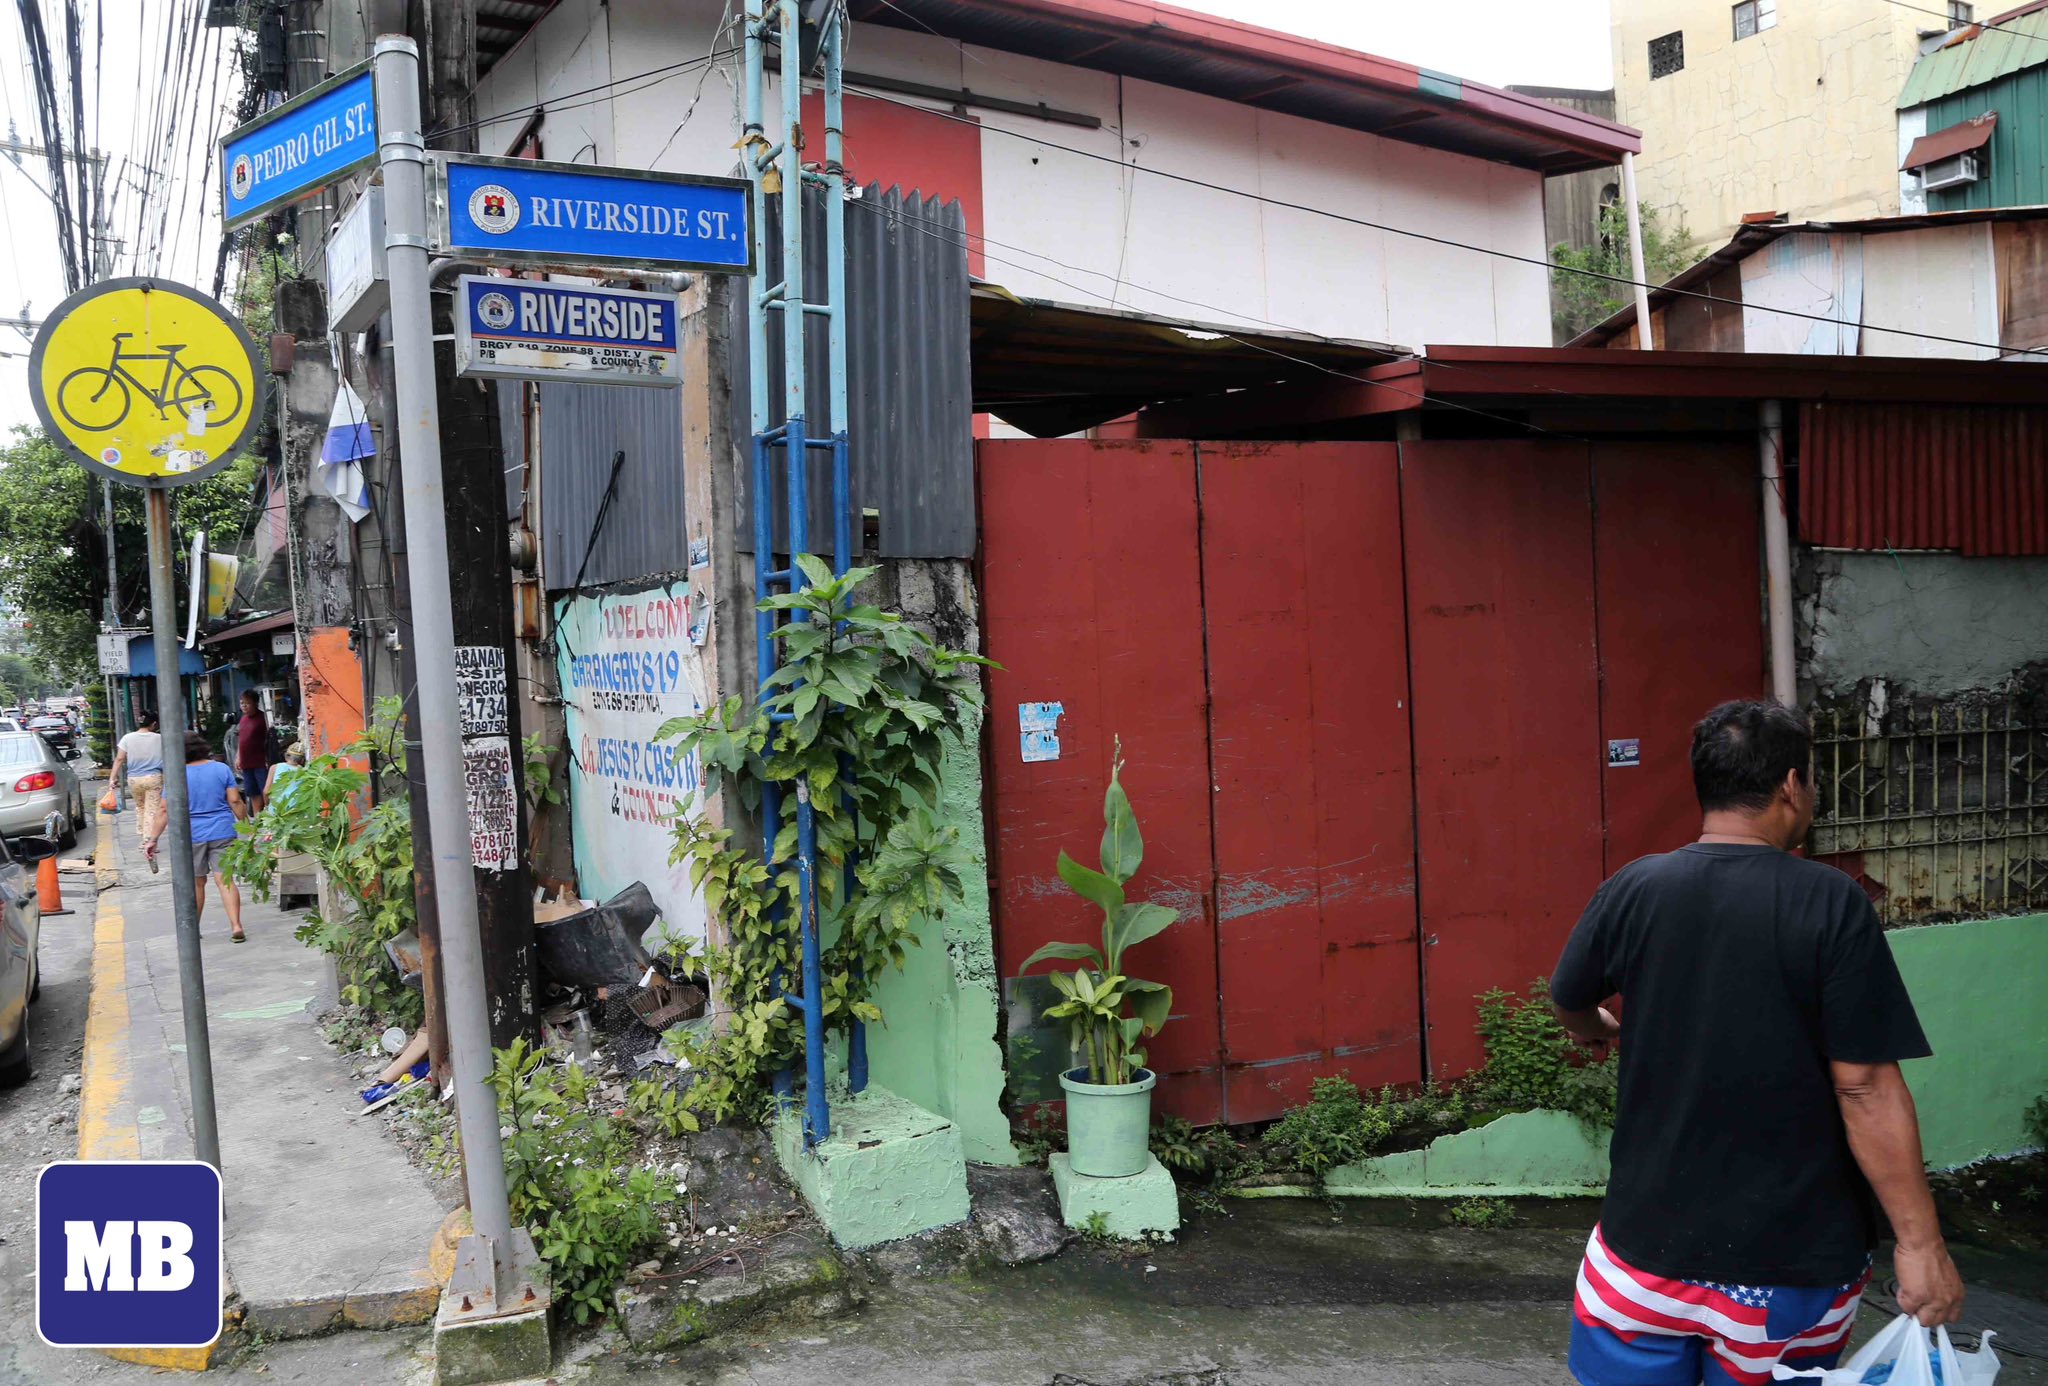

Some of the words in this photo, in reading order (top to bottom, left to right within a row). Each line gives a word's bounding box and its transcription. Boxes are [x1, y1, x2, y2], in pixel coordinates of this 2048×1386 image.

[254, 132, 309, 185] PEDRO
[313, 116, 342, 158] GIL
[345, 102, 373, 142] ST.
[530, 196, 690, 237] RIVERSIDE
[697, 209, 737, 241] ST.
[519, 291, 664, 342] RIVERSIDE
[479, 340, 512, 350] BRGY
[604, 349, 631, 358] DIST.
[633, 351, 642, 359] V
[479, 350, 496, 359] P/B
[591, 357, 598, 365] &
[600, 357, 643, 368] COUNCIL
[109, 657, 118, 665] TO
[571, 651, 640, 693] BARANGAY
[641, 650, 679, 694] 819
[597, 738, 631, 780] JESUS
